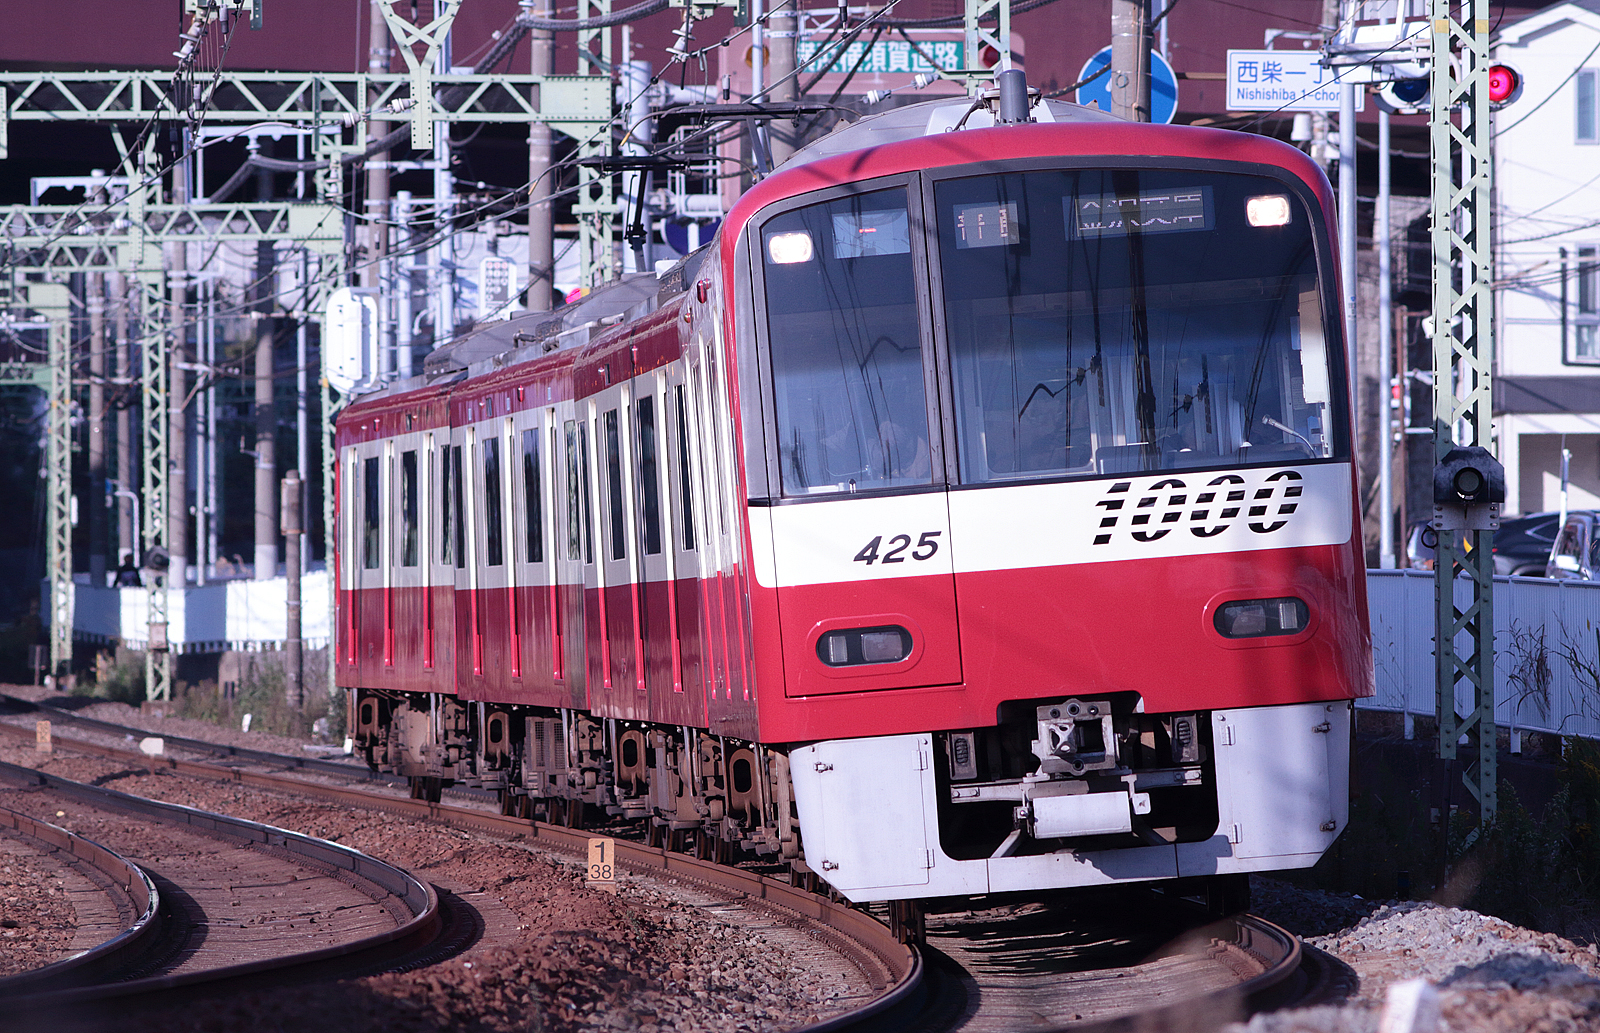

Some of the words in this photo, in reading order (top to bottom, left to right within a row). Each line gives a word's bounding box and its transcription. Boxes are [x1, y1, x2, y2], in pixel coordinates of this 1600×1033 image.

[1238, 61, 1340, 85] 西柴一丁
[1237, 87, 1296, 101] Nishishiba
[1093, 470, 1304, 546] 1000
[853, 531, 942, 566] 425
[594, 841, 605, 863] 1
[590, 864, 612, 879] 38
